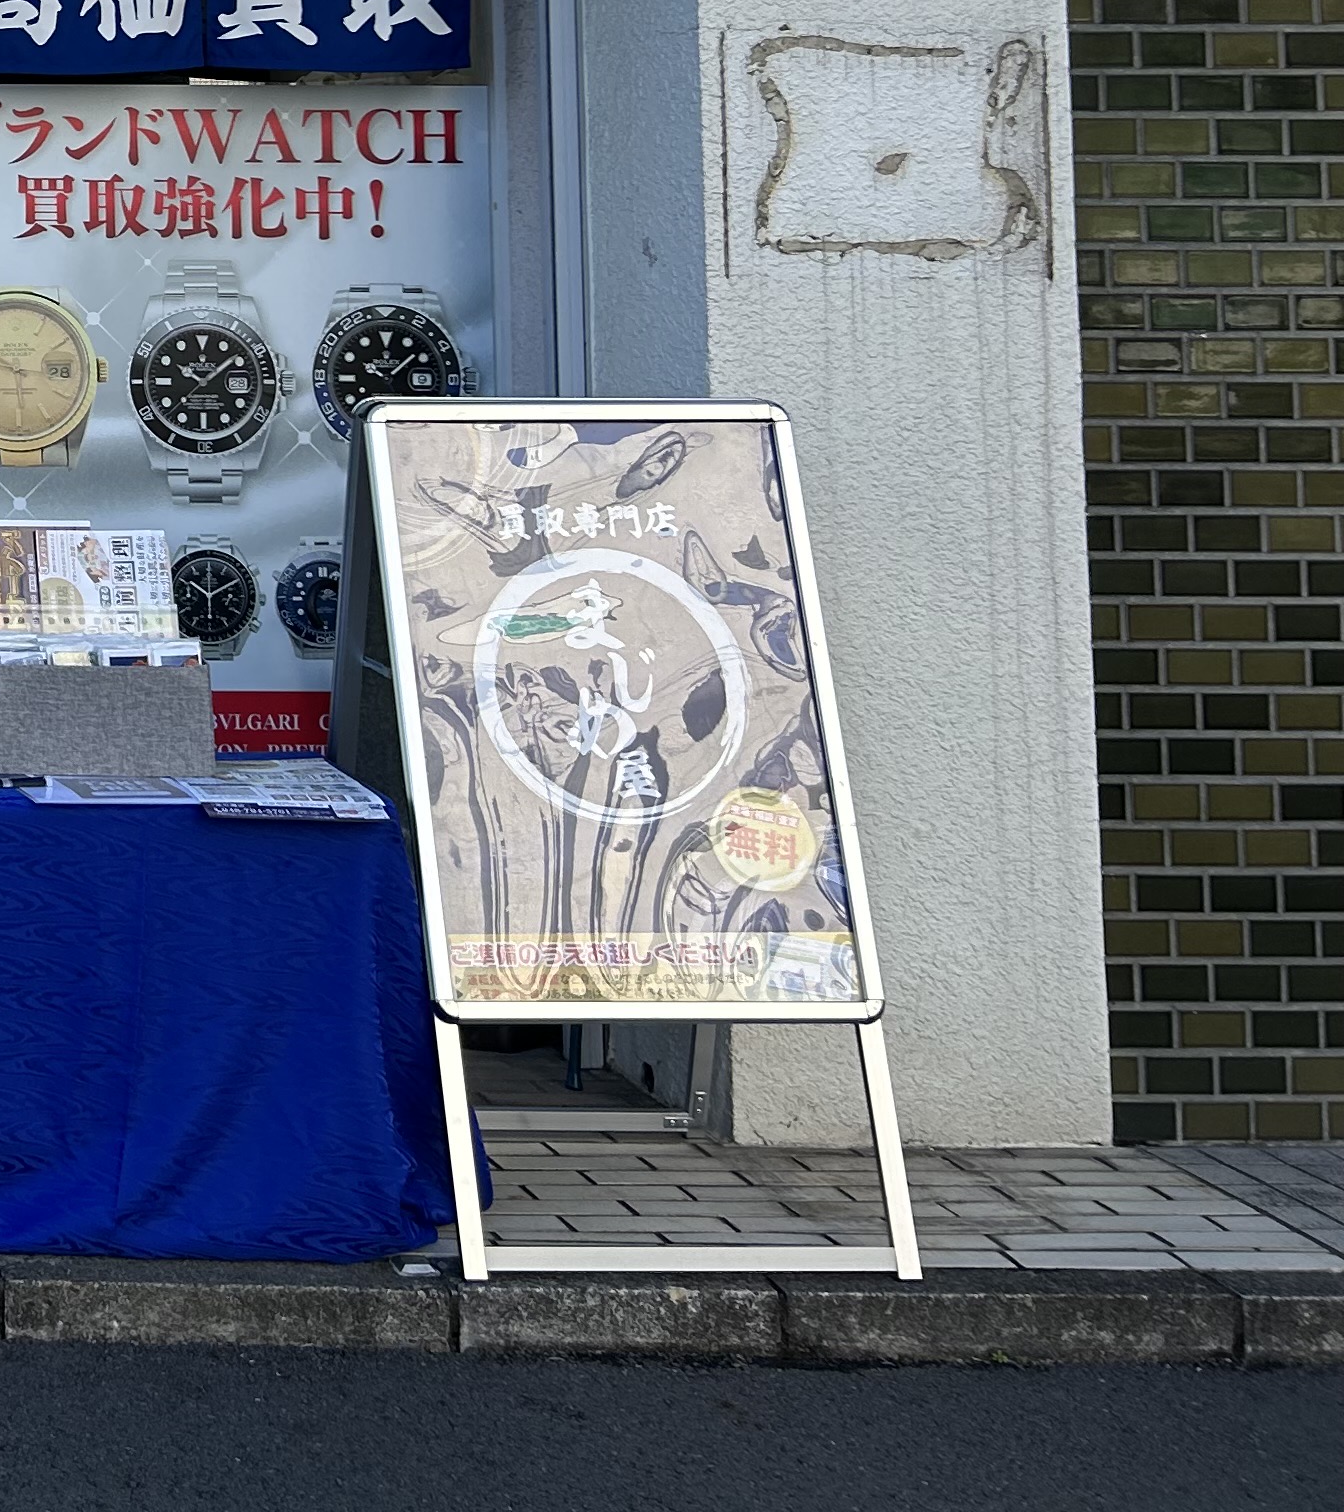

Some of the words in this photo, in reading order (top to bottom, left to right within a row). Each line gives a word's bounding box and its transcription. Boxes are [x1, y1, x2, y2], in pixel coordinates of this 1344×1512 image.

[13, 174, 387, 241] 買取強化中!
[48, 367, 70, 378] 28
[496, 502, 680, 541] 買取専門店
[565, 578, 662, 799] まじめ屋
[725, 825, 800, 870] 無料
